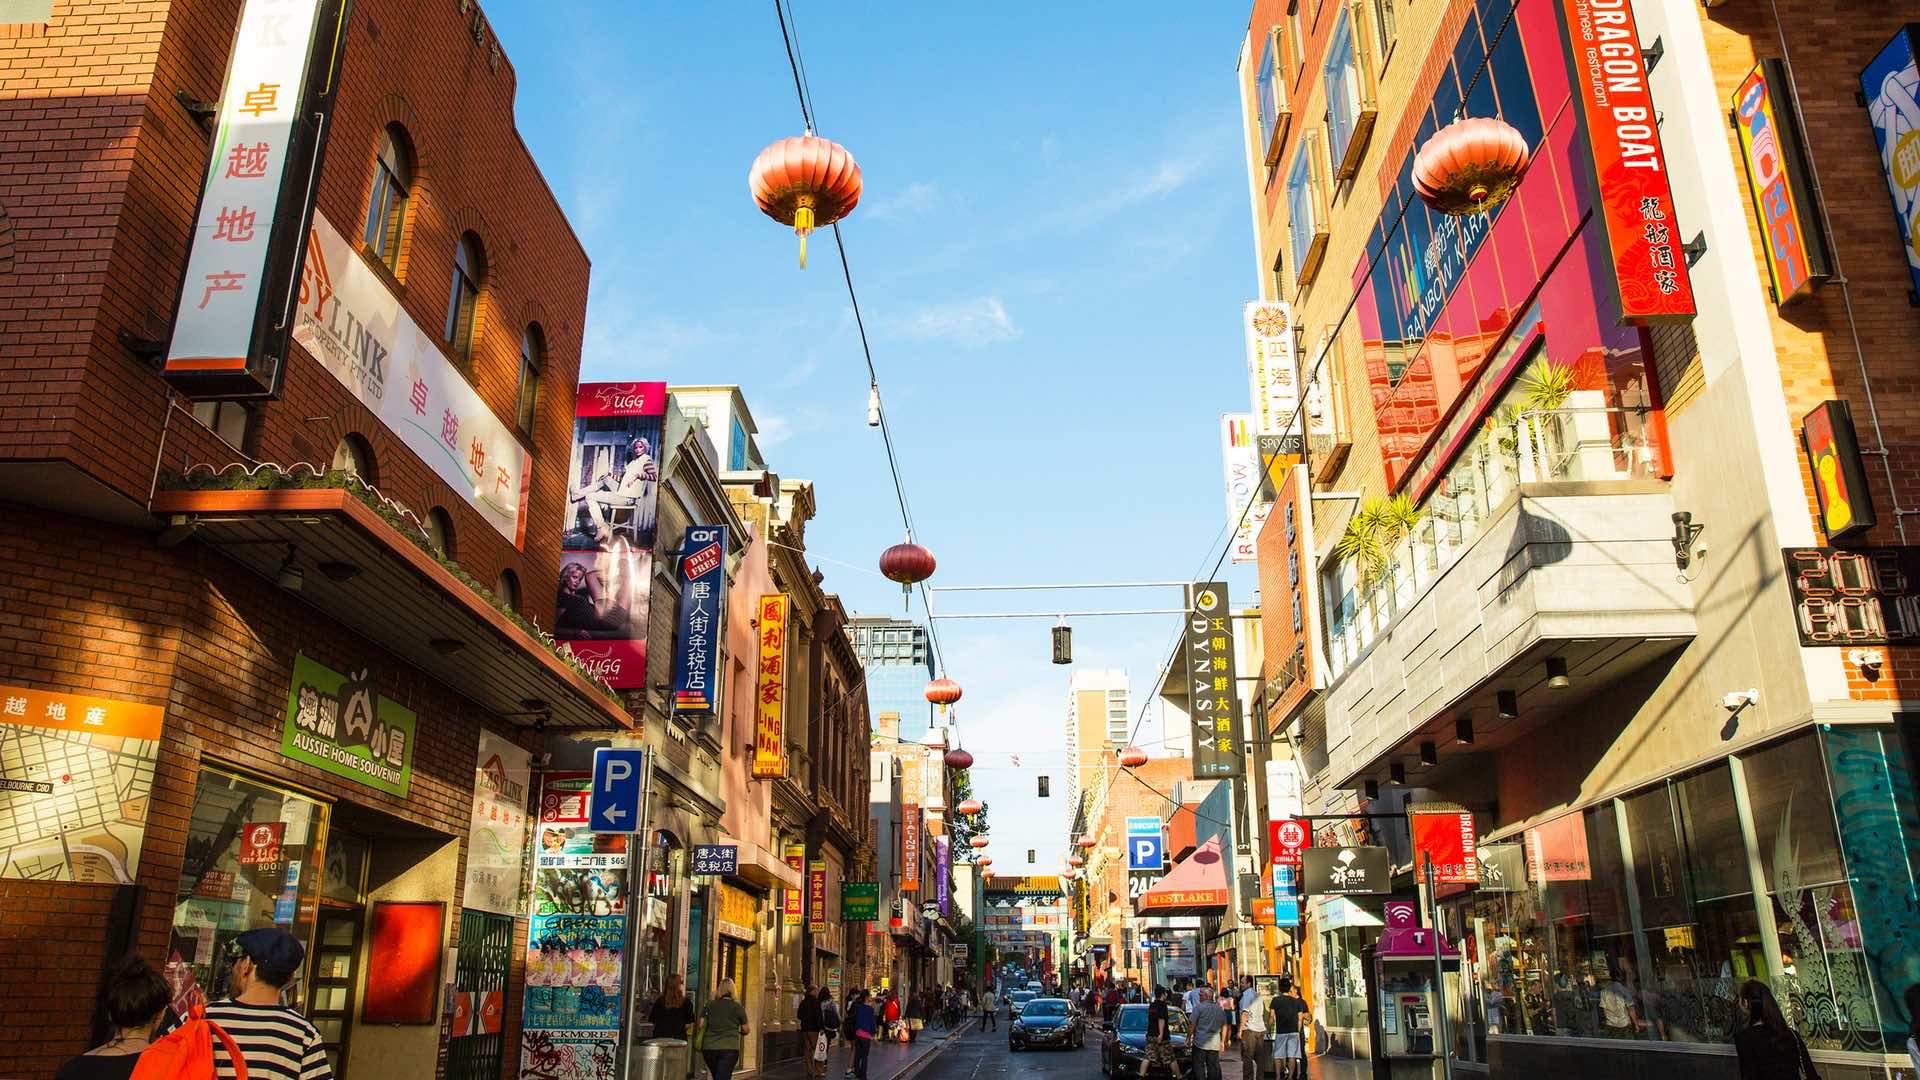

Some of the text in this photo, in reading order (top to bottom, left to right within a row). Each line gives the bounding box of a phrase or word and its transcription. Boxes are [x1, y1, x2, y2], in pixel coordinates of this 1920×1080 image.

[1586, 47, 1611, 107] restaurant
[1590, 0, 1660, 172] DRAGON BOAT
[199, 82, 281, 310] 卓越地产
[1639, 197, 1680, 294] 龍舫酒家
[367, 380, 382, 400] LTD
[614, 395, 645, 408] UGG
[1260, 438, 1300, 449] SPORTS
[690, 546, 717, 566] DUTY
[691, 558, 718, 576] FREE
[685, 581, 711, 689] 唐人街免税店
[590, 658, 621, 675] UGG
[1192, 619, 1216, 752] DYNASTY
[758, 707, 780, 736] LING
[759, 733, 779, 757] NAN
[293, 733, 401, 785] AUSSIE HOME SOUVENIR
[605, 760, 632, 792] P
[696, 848, 734, 860] 唐人街
[1136, 840, 1155, 865] P
[1460, 814, 1477, 881] DRAGON BOAT
[696, 860, 734, 872] 免税店
[1149, 892, 1214, 903] WESTLAKE
[786, 915, 801, 923] 202
[811, 923, 824, 931] 202
